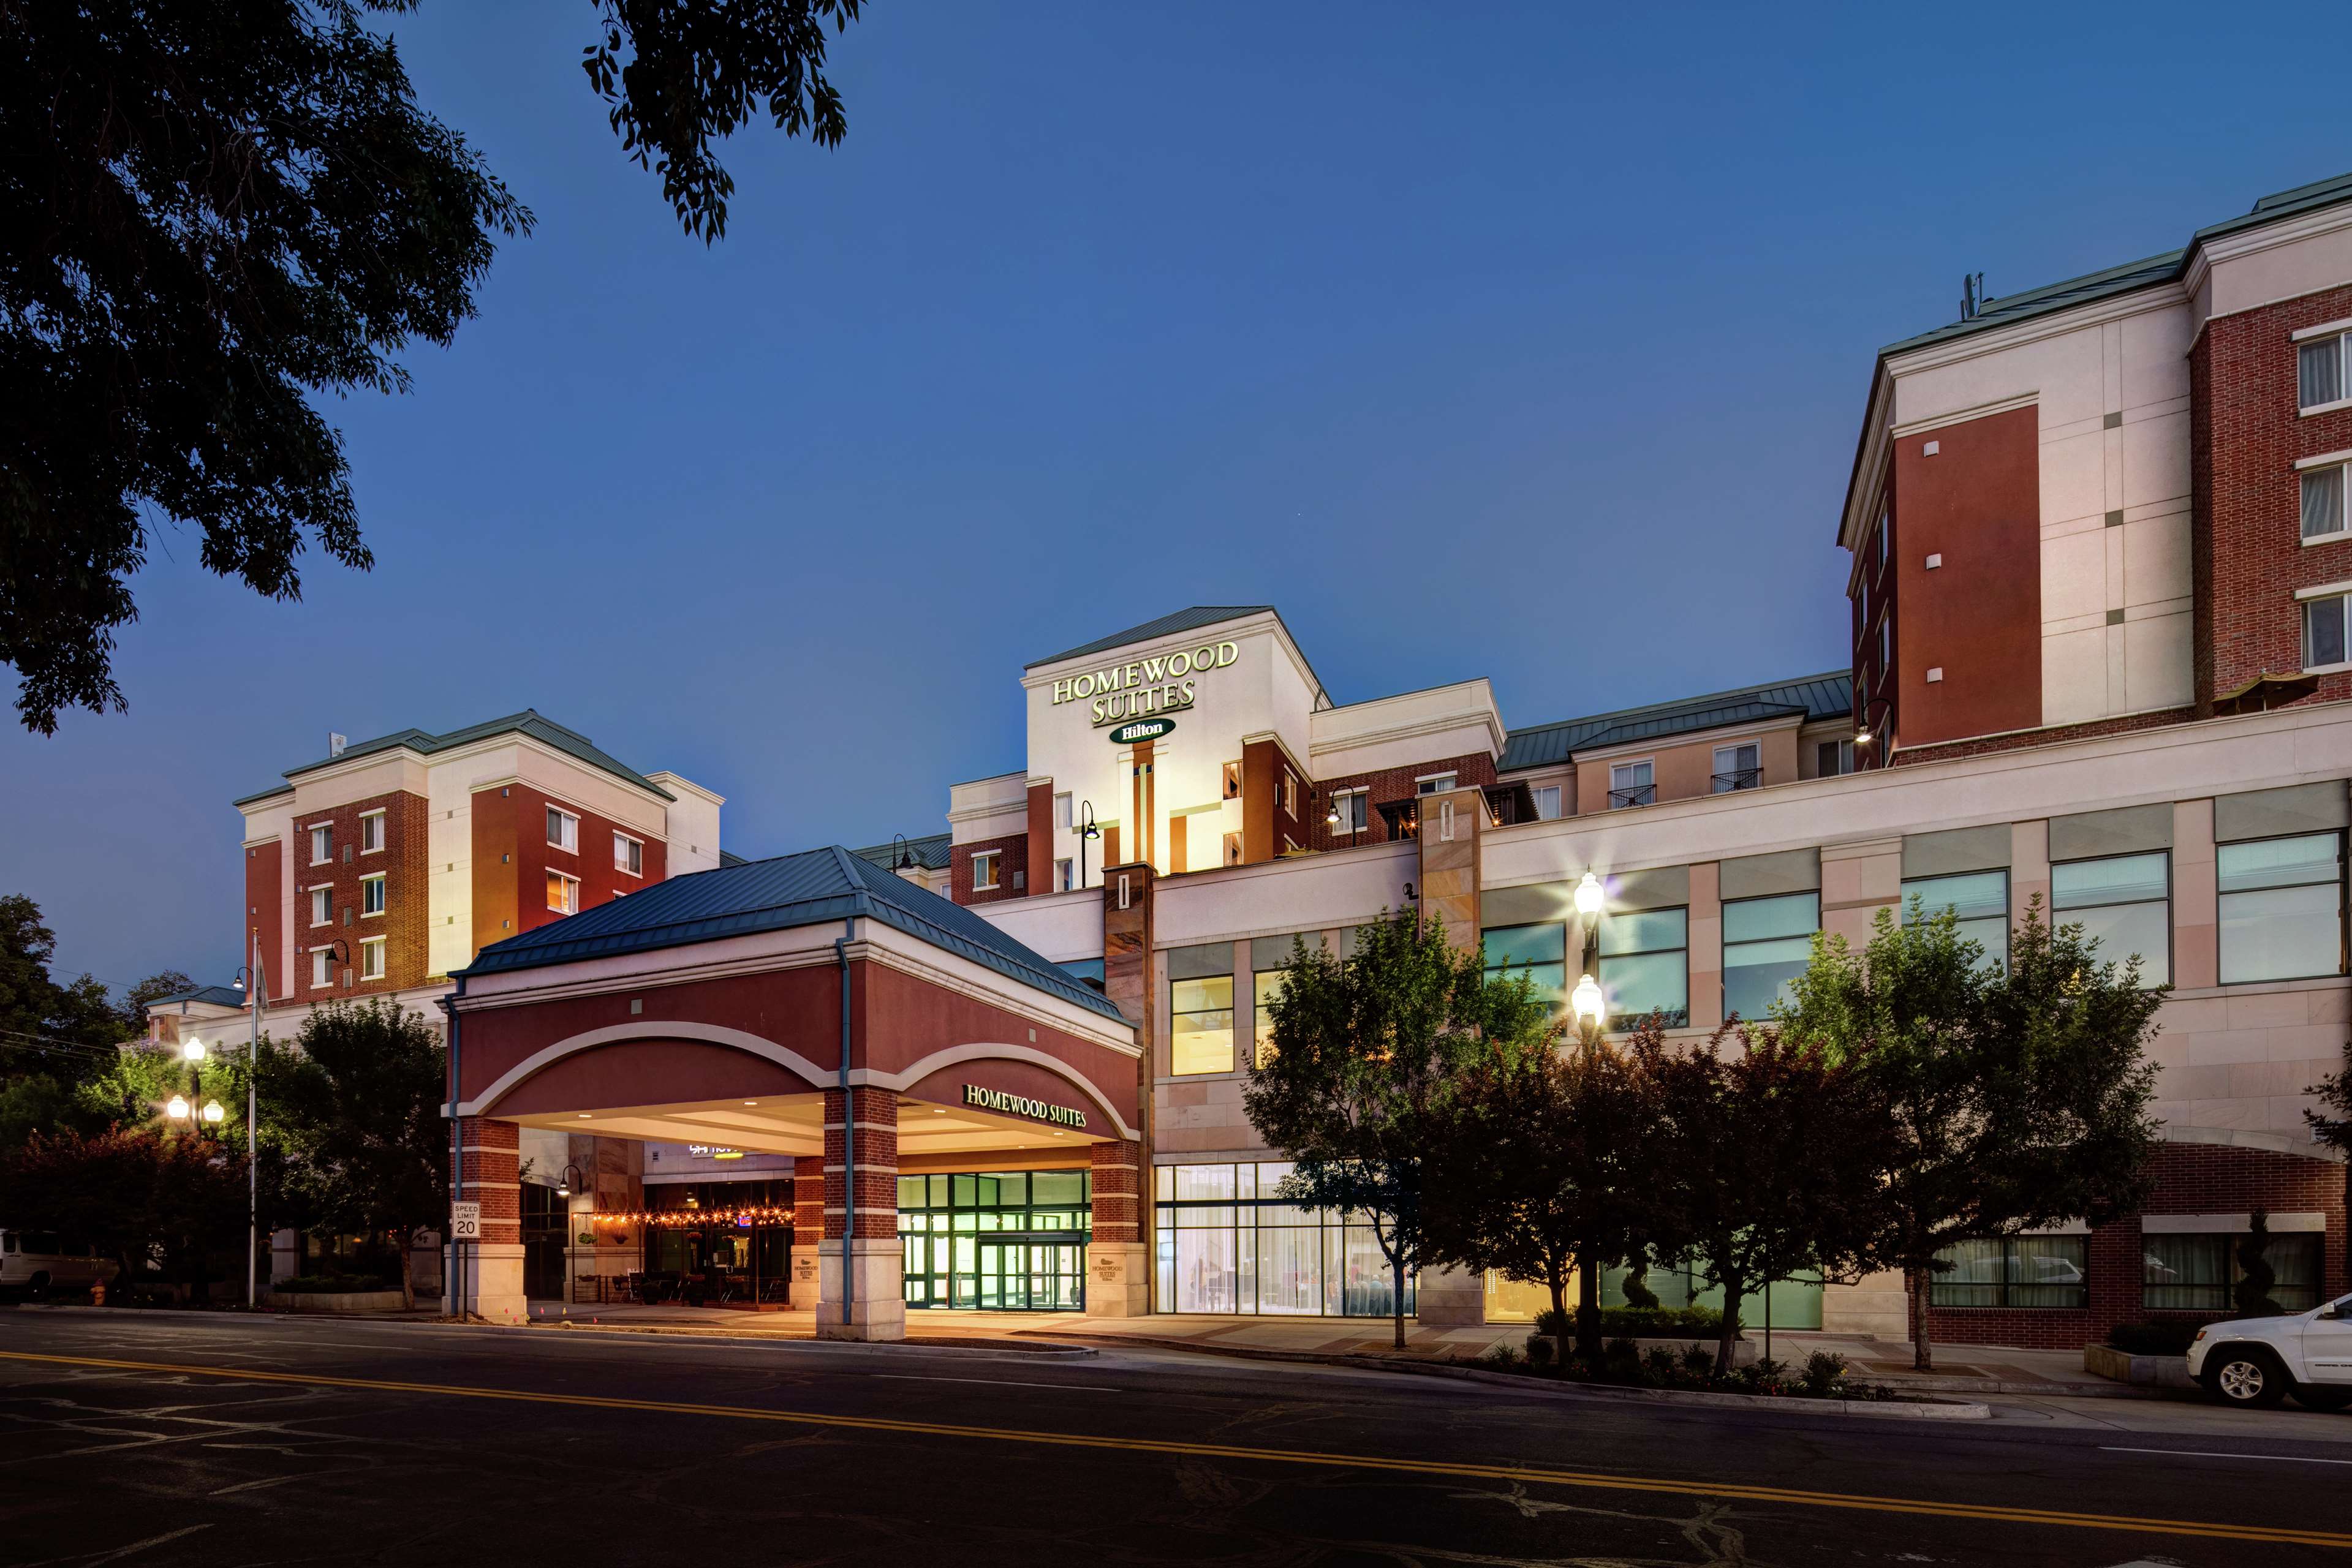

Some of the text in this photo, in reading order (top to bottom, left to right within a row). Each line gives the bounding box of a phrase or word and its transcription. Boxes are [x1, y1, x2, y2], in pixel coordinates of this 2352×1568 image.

[1053, 641, 1239, 704] HOMEWOOD
[1092, 680, 1195, 723] SUITES
[1122, 723, 1163, 740] Hilton
[966, 1084, 1087, 1128] HOMEWOOD SUITES
[457, 1221, 475, 1234] 20
